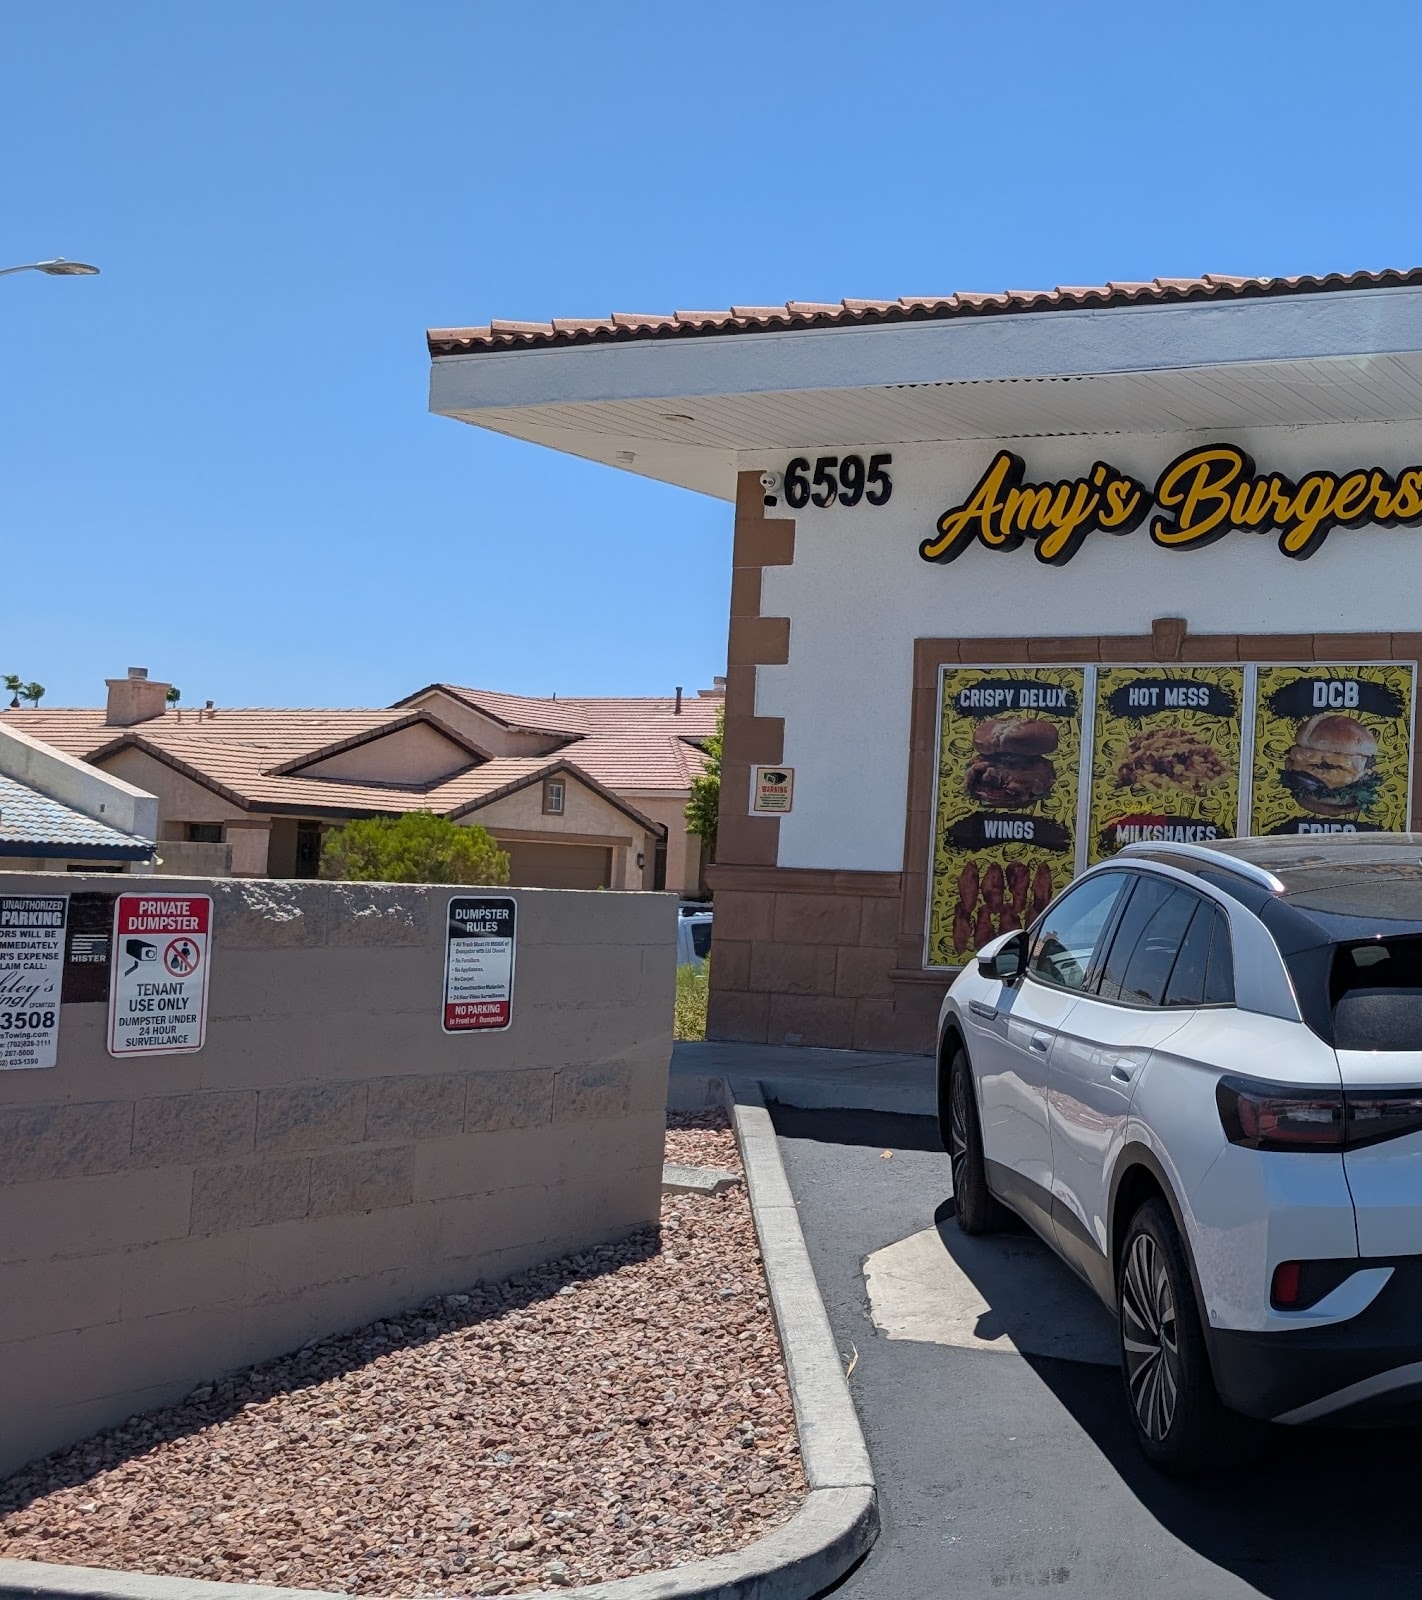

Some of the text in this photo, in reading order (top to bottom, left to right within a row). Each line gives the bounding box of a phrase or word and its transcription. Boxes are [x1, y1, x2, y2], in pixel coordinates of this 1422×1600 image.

[784, 453, 893, 509] 6595
[921, 451, 1146, 562] Amy's
[960, 689, 1067, 708] CRISPY DELUX
[1128, 687, 1209, 707] HOT MESS
[1312, 681, 1359, 708] DCB
[984, 820, 1035, 839] WINGS
[1116, 824, 1218, 843] MILKSHAKES
[2, 899, 64, 911] UNAUTHORIZED
[139, 901, 192, 915] PRIVATE
[1, 910, 63, 927] PARKING
[455, 908, 510, 920] DUMPSTER
[128, 916, 200, 931] DUMPSTER
[466, 921, 499, 933] RULES
[20, 930, 41, 938] WILL
[44, 930, 57, 938] BE
[17, 952, 60, 961] EXPENSE
[71, 954, 107, 963] HISTER
[136, 982, 185, 997] TENANT
[129, 997, 190, 1012] USE ONLY
[455, 1003, 501, 1015] NO PARKING
[0, 1011, 56, 1030] 3508
[118, 1013, 198, 1027] DUMPSTER UNDER
[455, 1017, 470, 1025] Front
[470, 1016, 477, 1024] of
[138, 1025, 177, 1036] 24 HOUR
[125, 1034, 190, 1048] SURVEILLANCE
